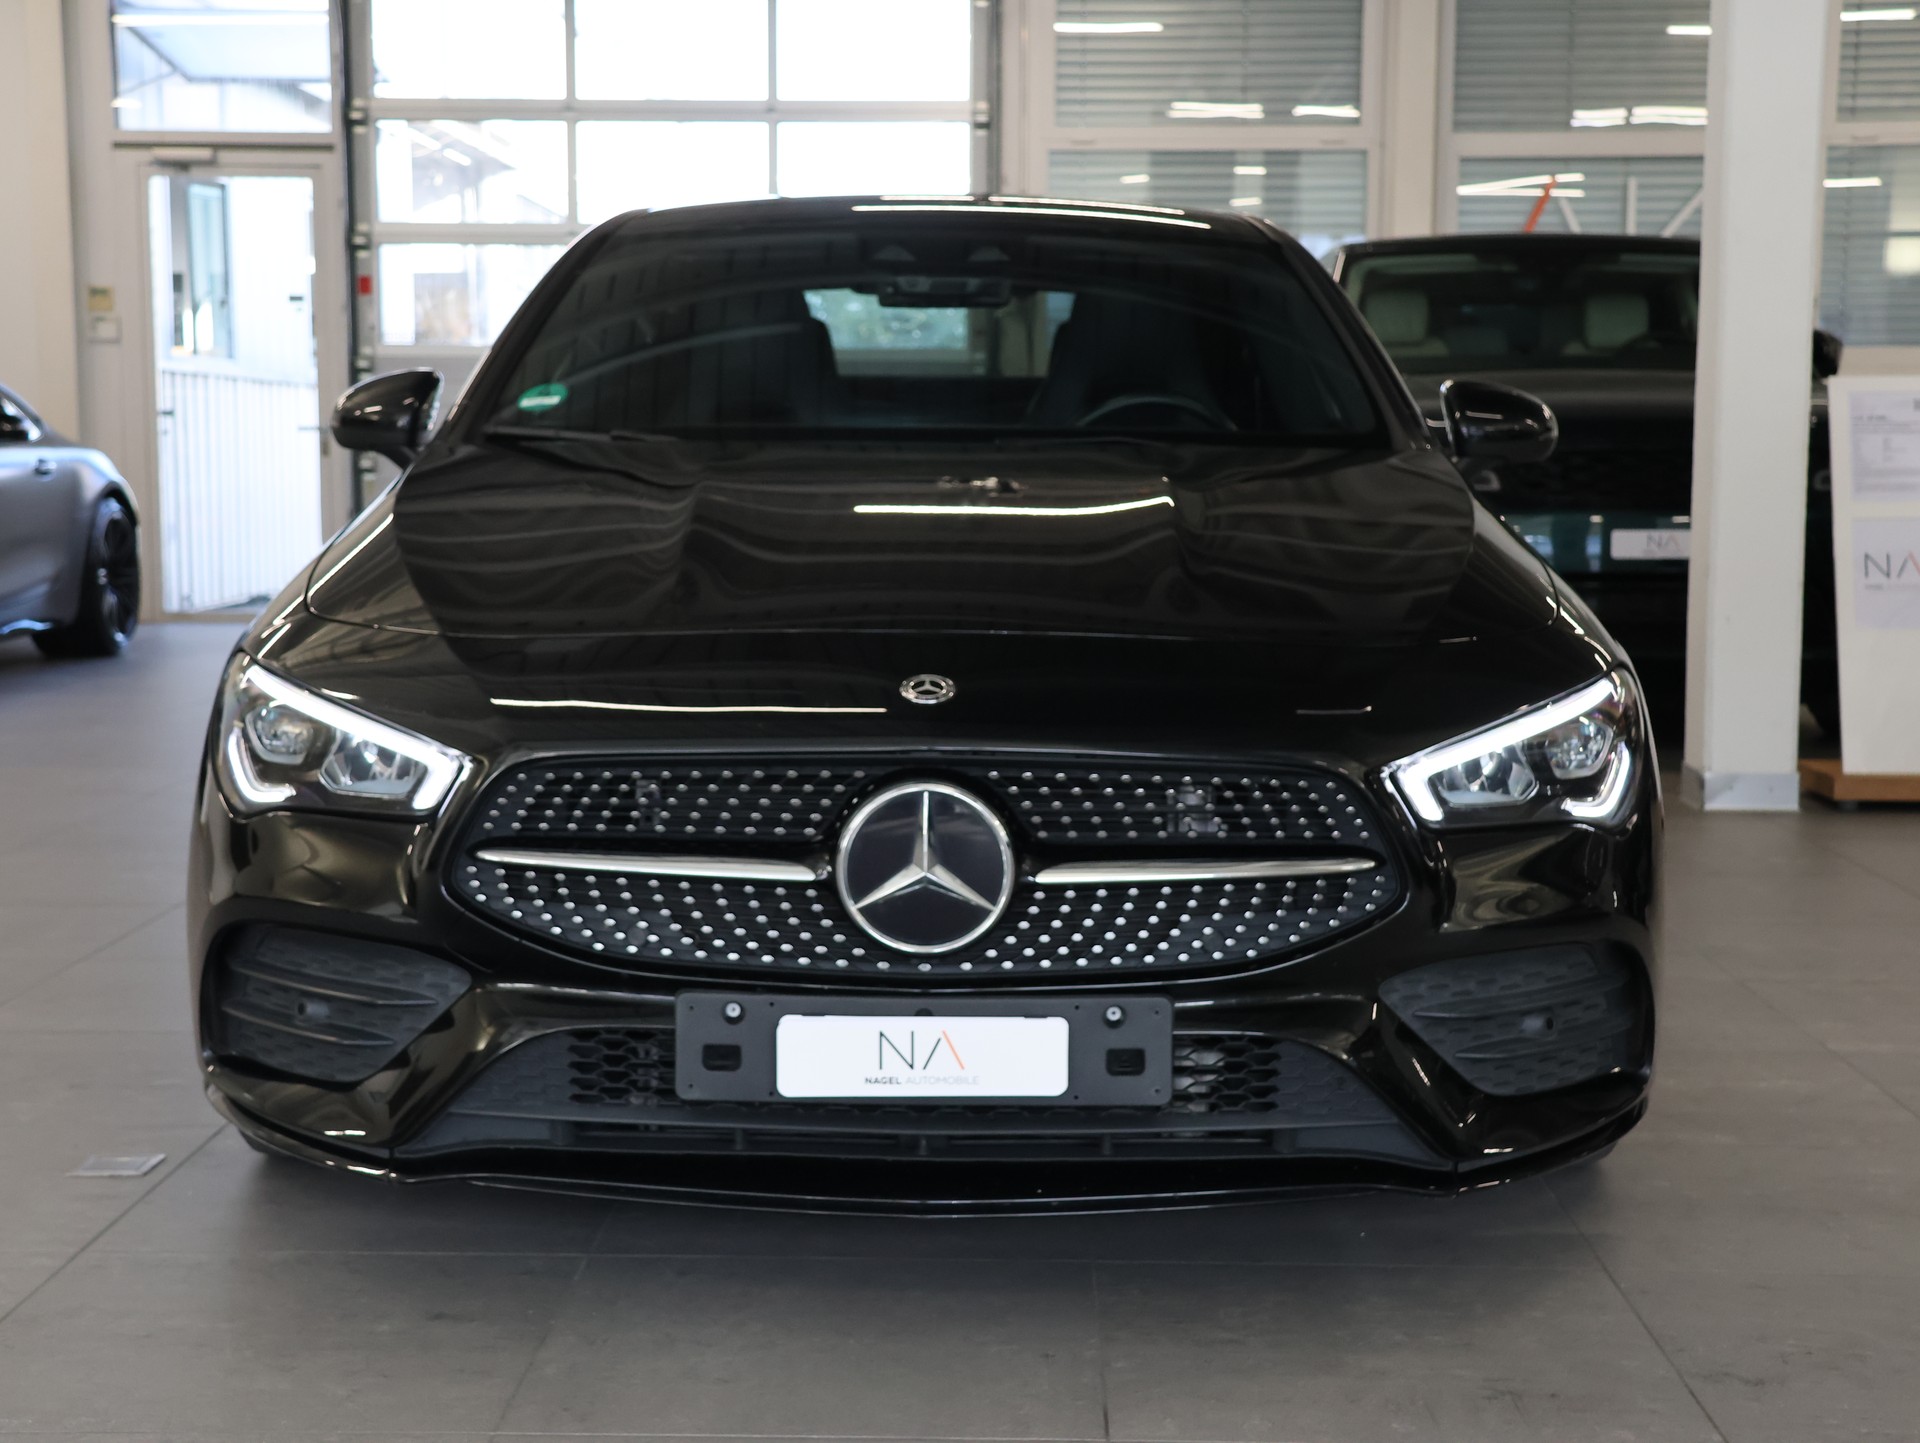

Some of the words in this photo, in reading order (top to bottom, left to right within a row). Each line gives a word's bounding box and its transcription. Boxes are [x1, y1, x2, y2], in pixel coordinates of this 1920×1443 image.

[879, 1030, 965, 1070] NA
[865, 1076, 901, 1085] NAGEL
[905, 1076, 979, 1086] AUTOMOBILE
